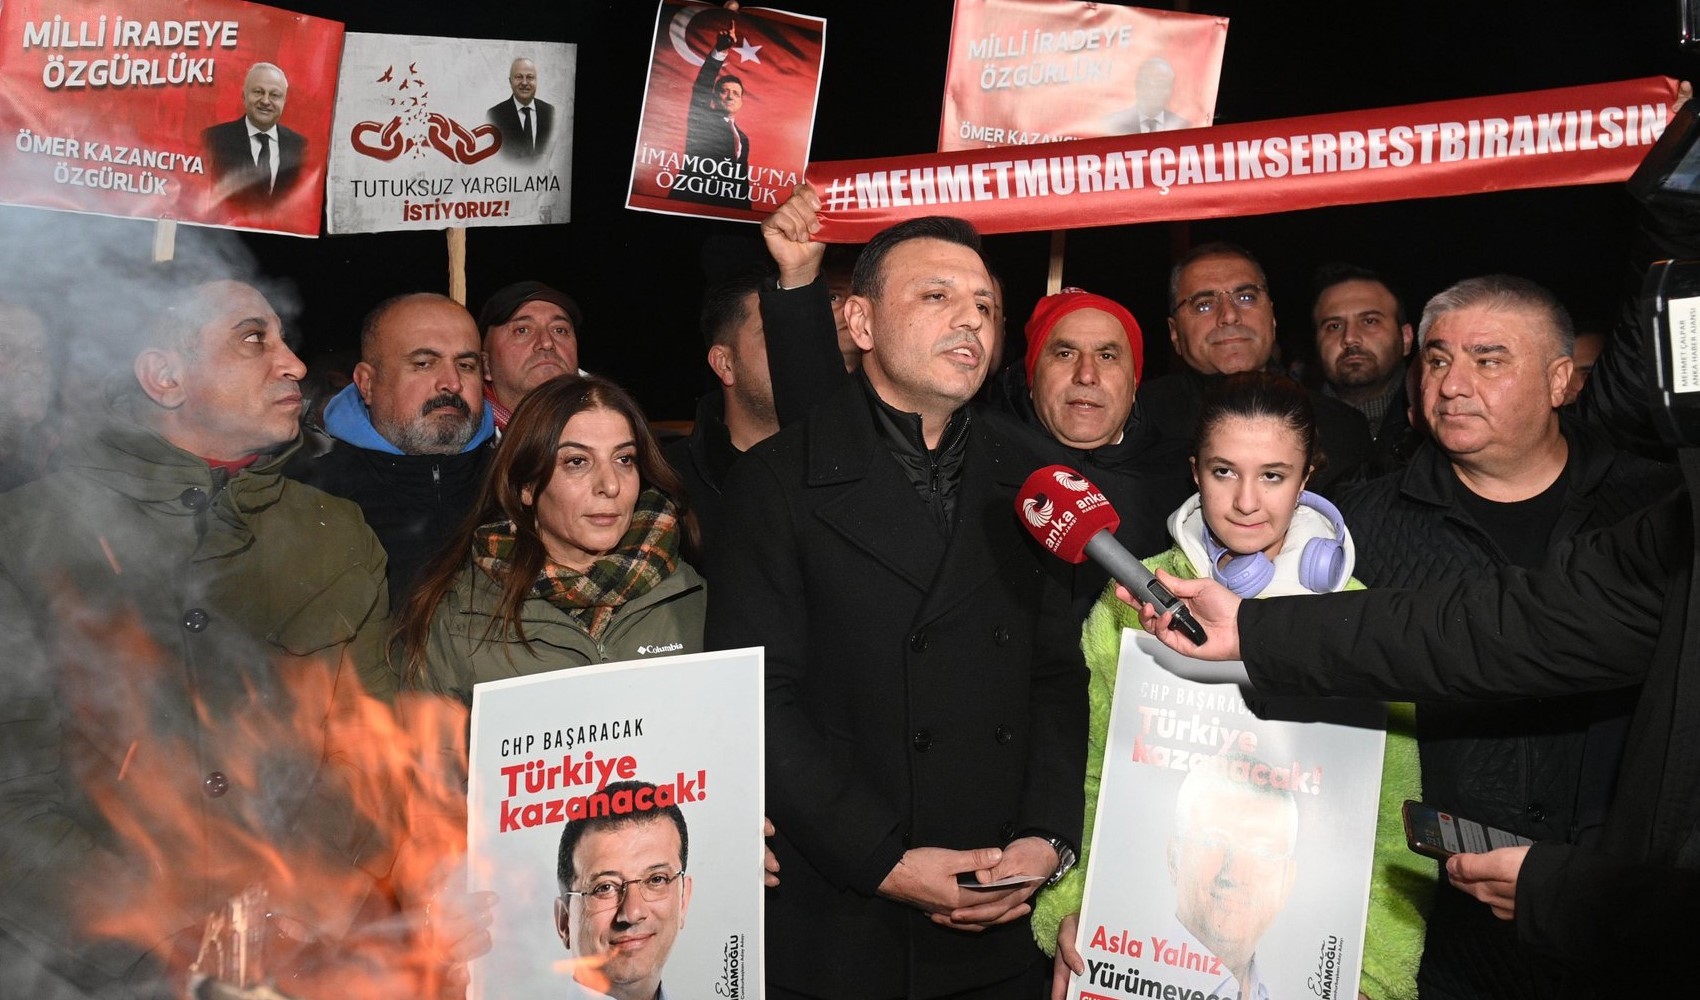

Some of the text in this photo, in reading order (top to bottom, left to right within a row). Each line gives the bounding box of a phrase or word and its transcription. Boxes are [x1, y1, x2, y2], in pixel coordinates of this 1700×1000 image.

[23, 14, 240, 49] MİLLİ İRADEYE
[968, 25, 1132, 60] MİLLİ İRADEYE
[42, 51, 214, 88] ÖZGÜRLÜK!
[980, 57, 1113, 91] ÖZGÜRLÜK!
[960, 121, 1005, 143] ÖMER
[15, 128, 204, 174] ÖMER KAZANCI'YA
[640, 142, 798, 188] İMAMOĞLU'NA
[824, 103, 1668, 212] #MEHMETMURATÇALIKSERBESTBIRAKILSIN
[53, 162, 167, 196] ÖZGÜRLÜK
[350, 175, 561, 198] TUTUKSUZ YARGILAMA
[656, 167, 778, 205] ÖZGÜRLÜK
[403, 198, 510, 222] İSTİYORUZ!
[1680, 352, 1689, 387] MEHMET
[1076, 491, 1107, 509] anka
[1046, 511, 1075, 548] anka
[646, 643, 684, 654] Columbia
[1140, 681, 1170, 701] CHP
[501, 718, 644, 757] CHP BAŞARACAK
[1136, 704, 1258, 755] Türkiye
[500, 751, 638, 798] Türkiye
[500, 770, 707, 833] kazanacak!
[1090, 925, 1224, 976] Asla Yalnız
